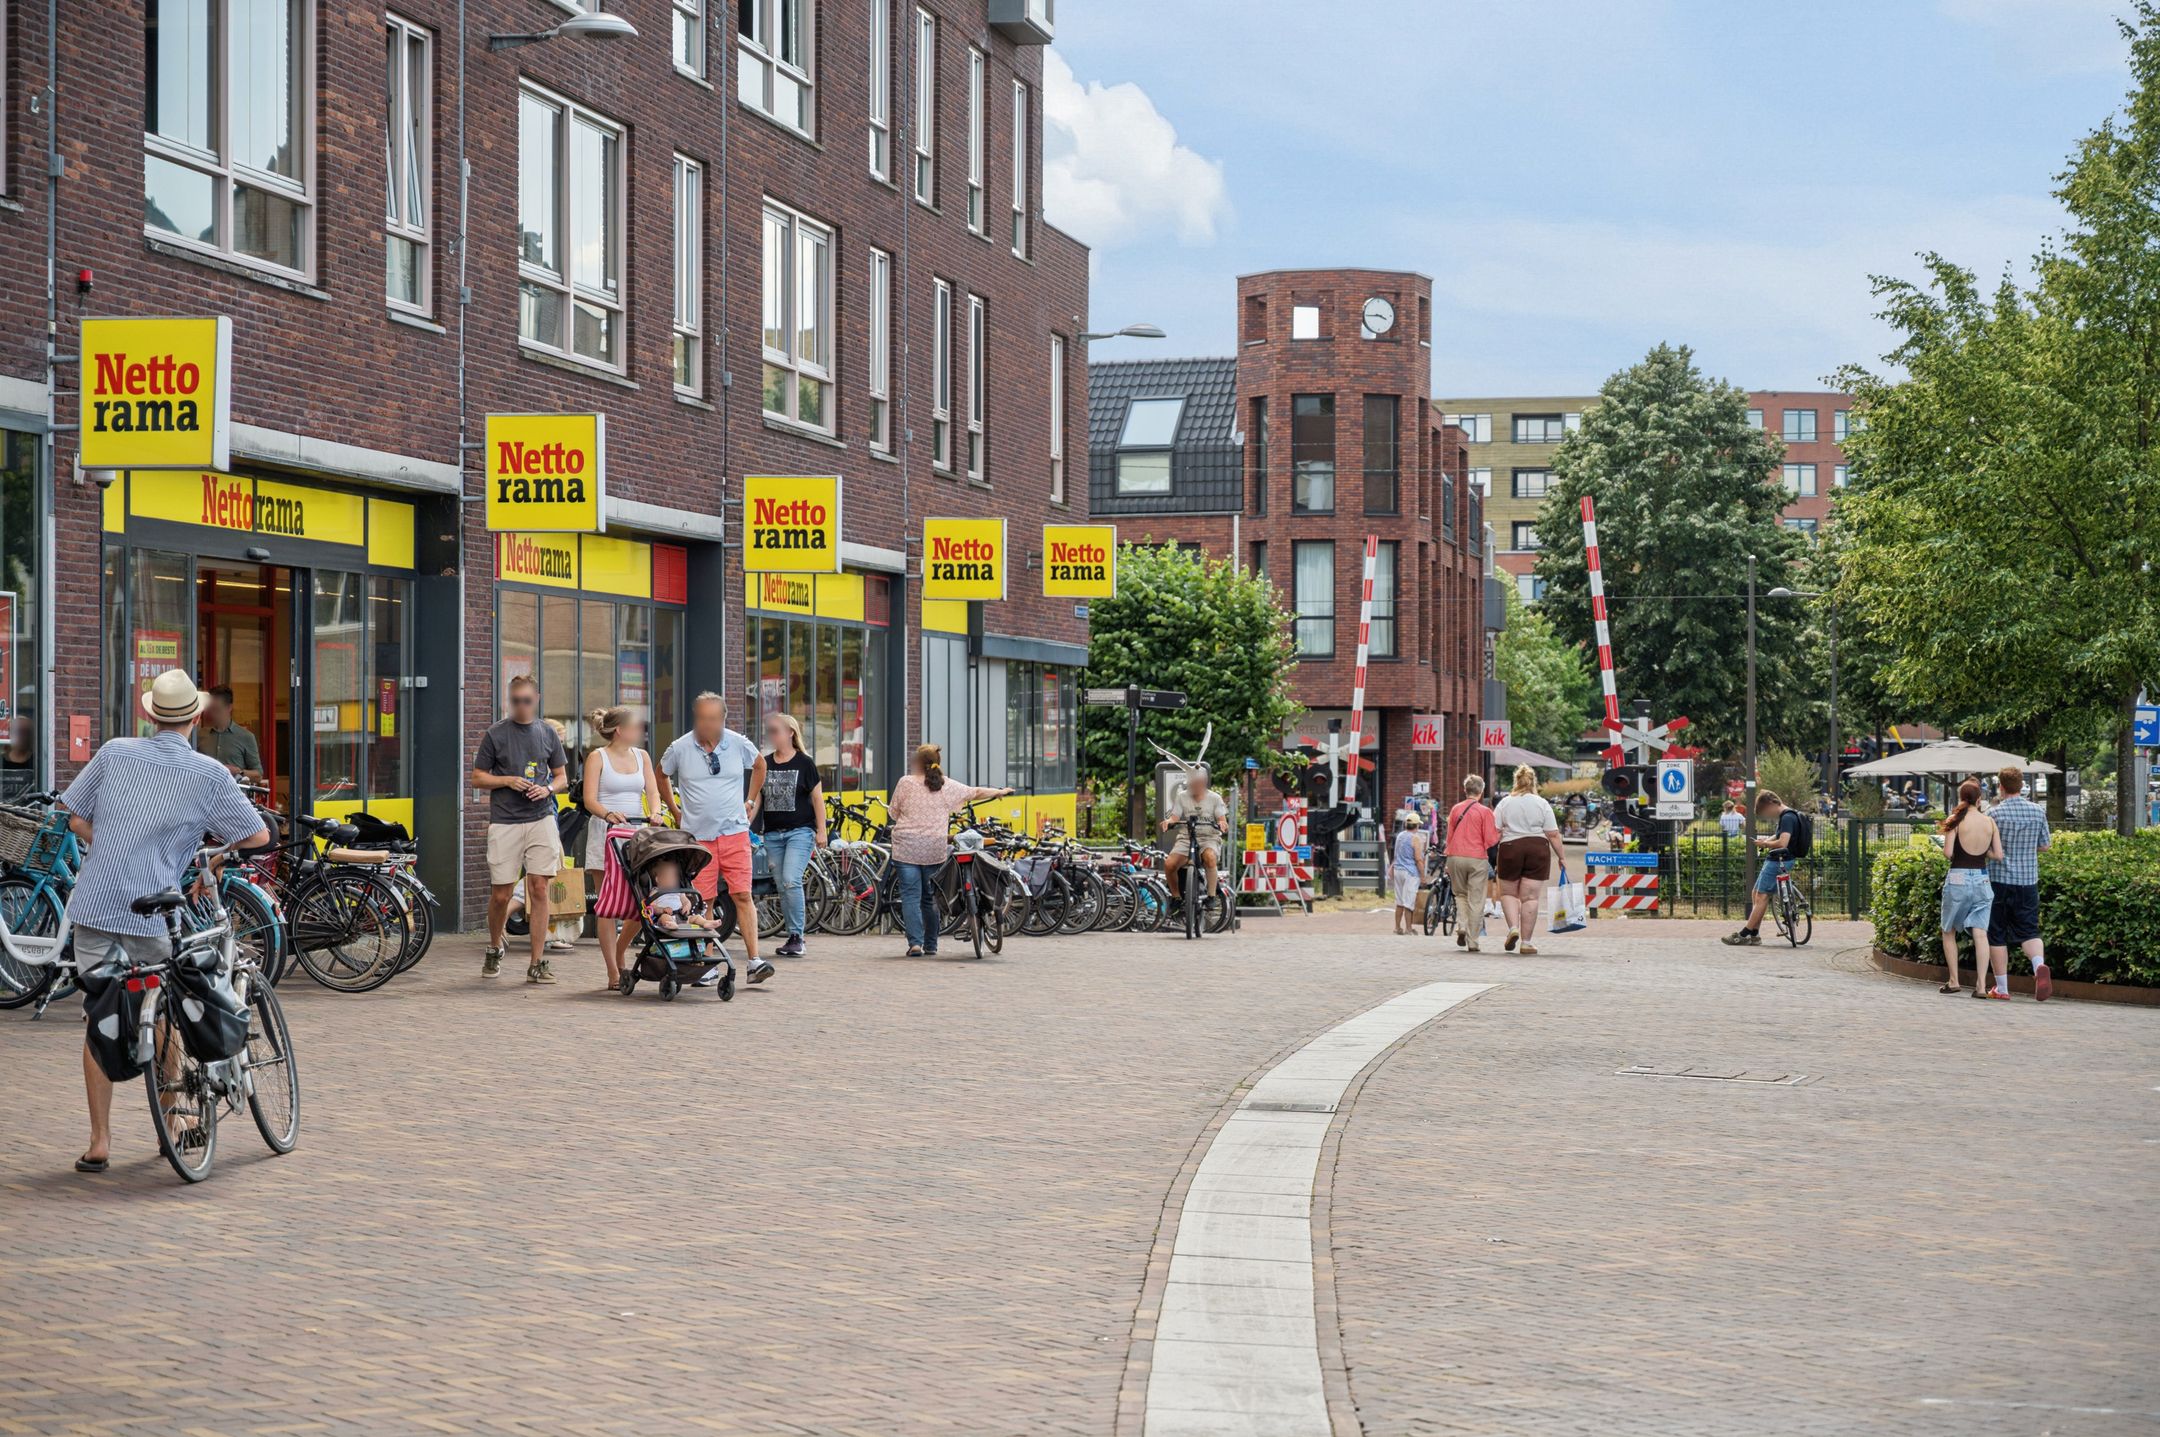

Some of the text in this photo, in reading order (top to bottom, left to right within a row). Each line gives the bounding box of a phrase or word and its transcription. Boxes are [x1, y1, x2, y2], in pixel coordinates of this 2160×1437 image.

[94, 353, 200, 395] Netto
[94, 399, 200, 432] rama
[497, 441, 585, 475] Netto
[497, 478, 586, 503] rama
[201, 474, 305, 536] Nettorama
[753, 498, 826, 526] Netto
[753, 528, 827, 549] rama
[932, 537, 994, 561] Netto
[505, 532, 572, 579] Nettorama
[1051, 542, 1105, 563] Netto
[932, 563, 994, 581] rama
[1050, 565, 1106, 581] rama
[763, 572, 810, 607] Nettorama
[1587, 855, 1617, 863] WACHT
